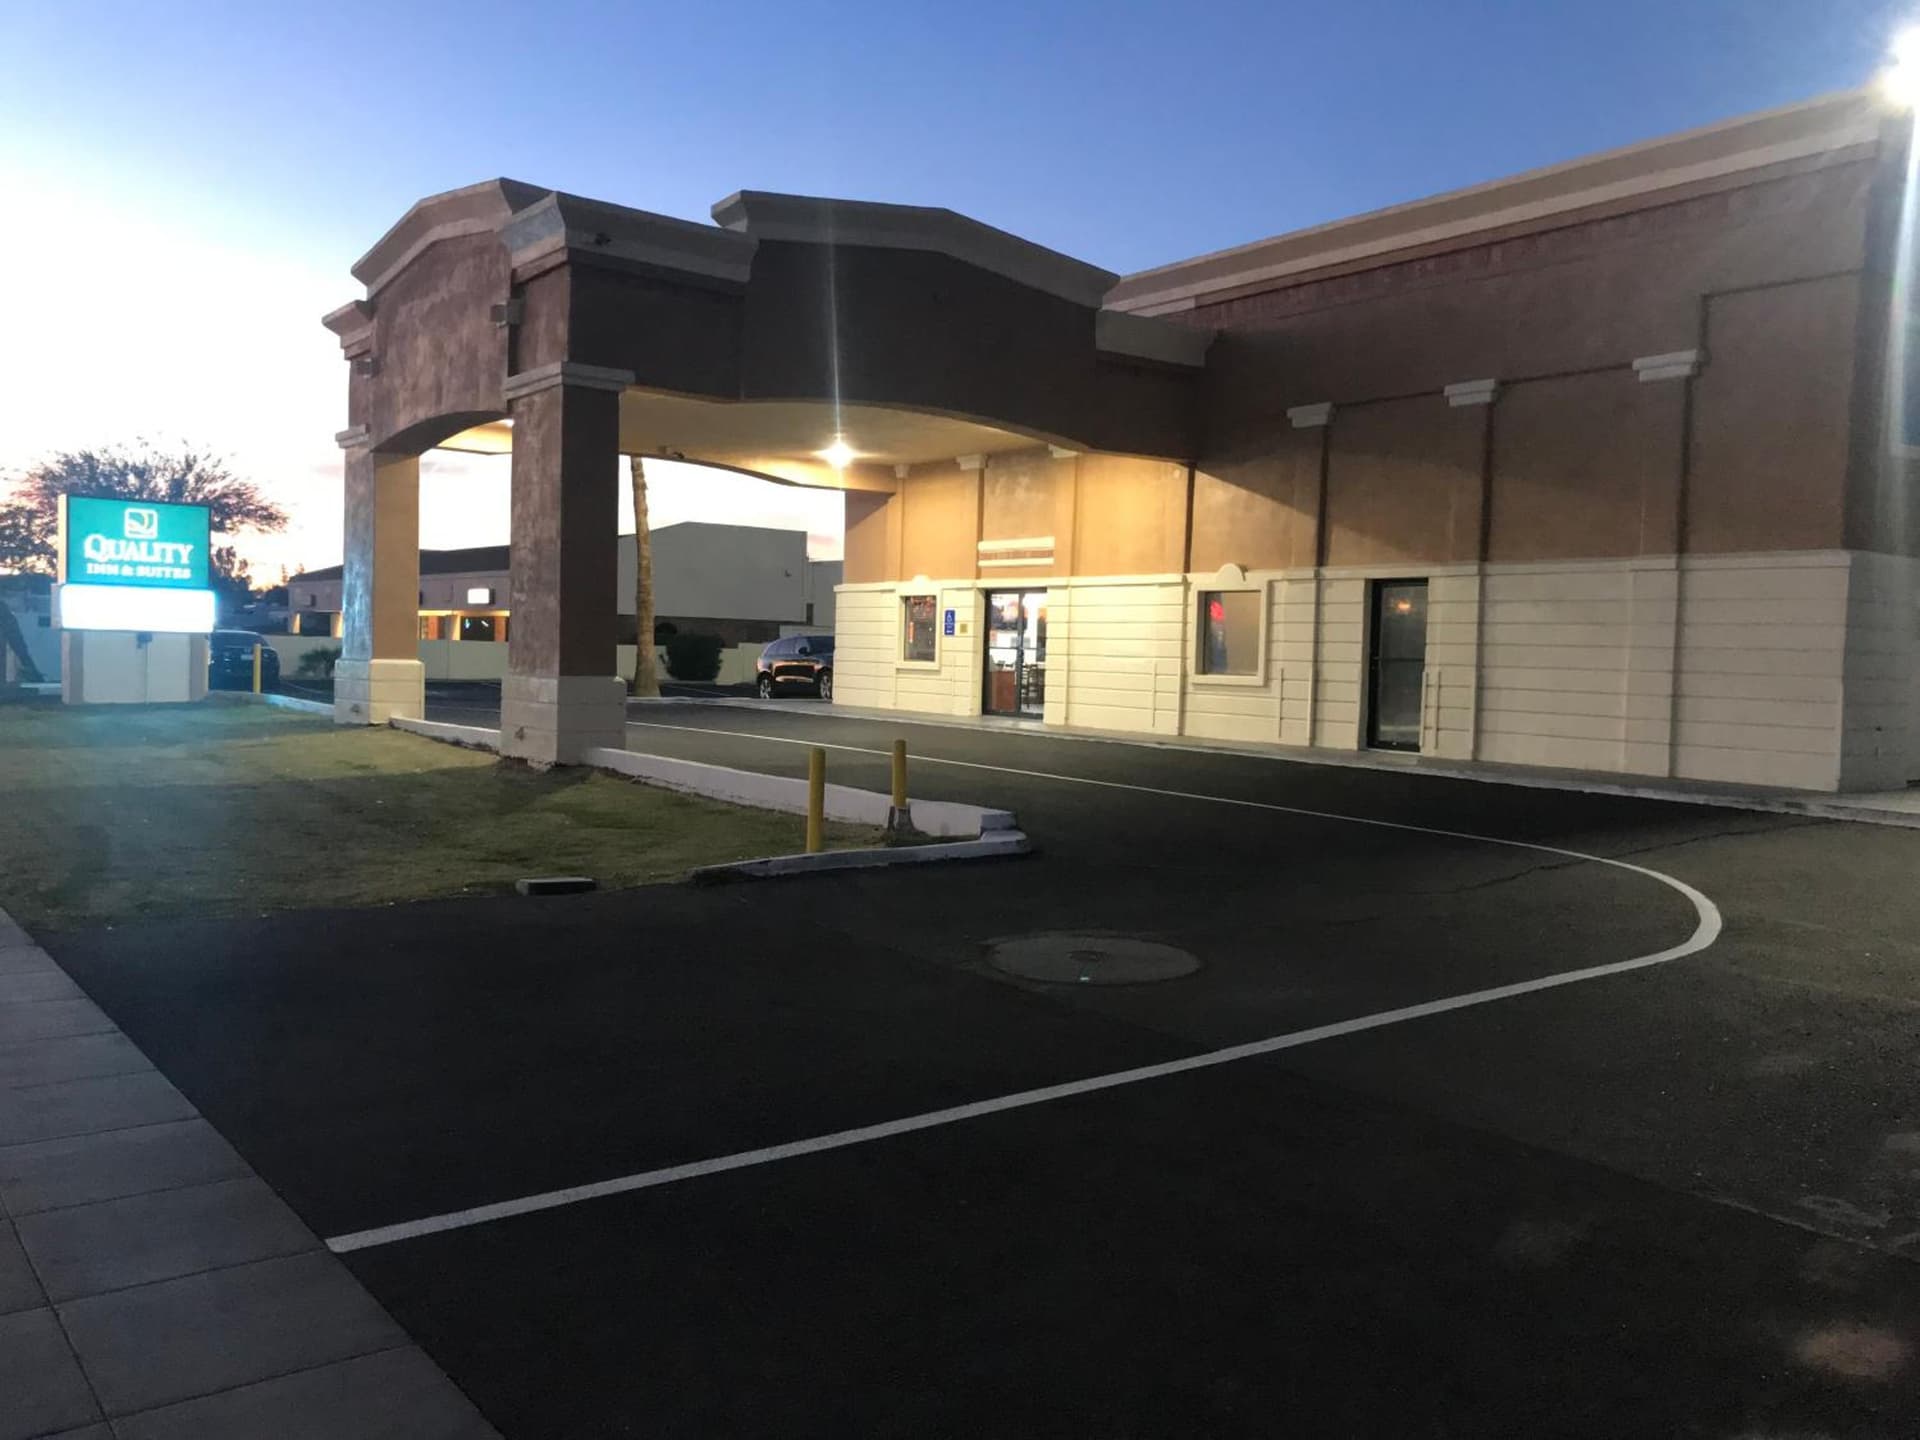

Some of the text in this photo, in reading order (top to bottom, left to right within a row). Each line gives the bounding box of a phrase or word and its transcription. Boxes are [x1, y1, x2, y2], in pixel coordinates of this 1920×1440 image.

[84, 534, 194, 564] QUALITY
[87, 563, 192, 579] INN & SUITES
